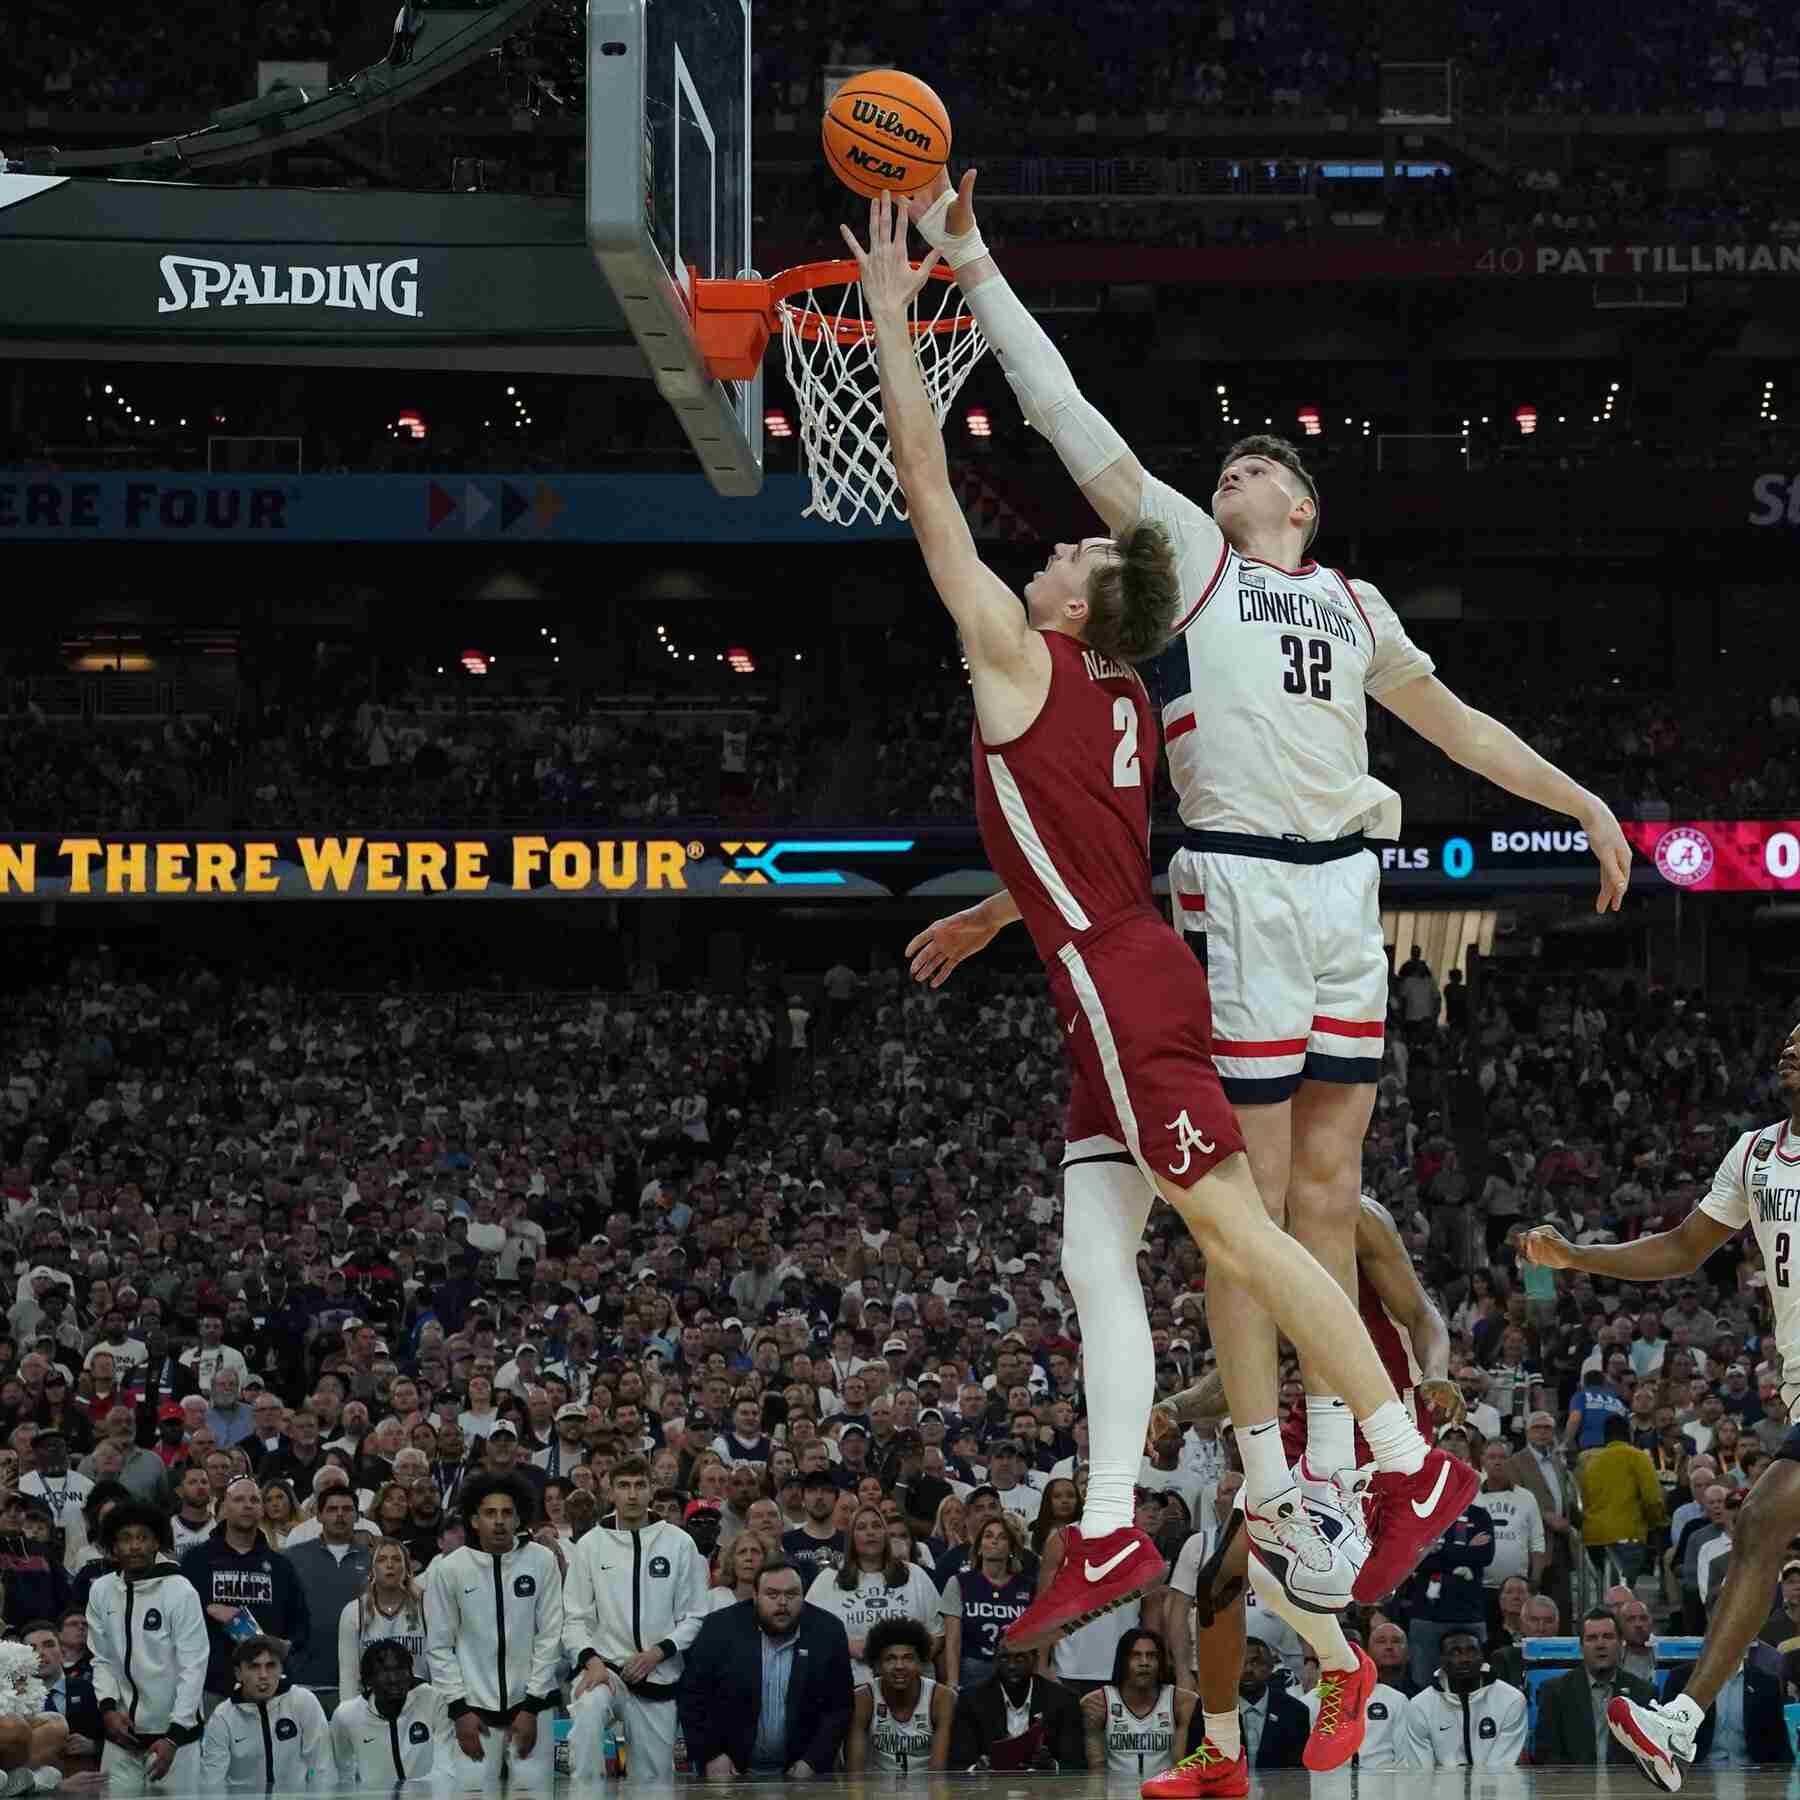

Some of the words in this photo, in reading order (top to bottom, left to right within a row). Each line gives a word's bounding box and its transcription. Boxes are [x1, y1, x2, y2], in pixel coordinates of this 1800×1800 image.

[852, 100, 931, 151] Wilson
[847, 146, 906, 181] NCAA
[158, 254, 419, 318] SPALDING
[1472, 248, 1526, 273] 40
[1536, 247, 1612, 273] PAT
[1624, 247, 1800, 273] TILLMAN
[1238, 589, 1357, 647] CONNECTICUT
[1280, 634, 1332, 701] 32
[1113, 696, 1142, 788] 2
[57, 837, 281, 894] THERE
[297, 836, 490, 892] WERE
[1381, 847, 1430, 871] FLS
[1441, 836, 1474, 880] 0
[1490, 830, 1590, 853] BONUS
[1765, 831, 1800, 880] 0
[1164, 1108, 1217, 1176] A
[1775, 1232, 1791, 1289] 2
